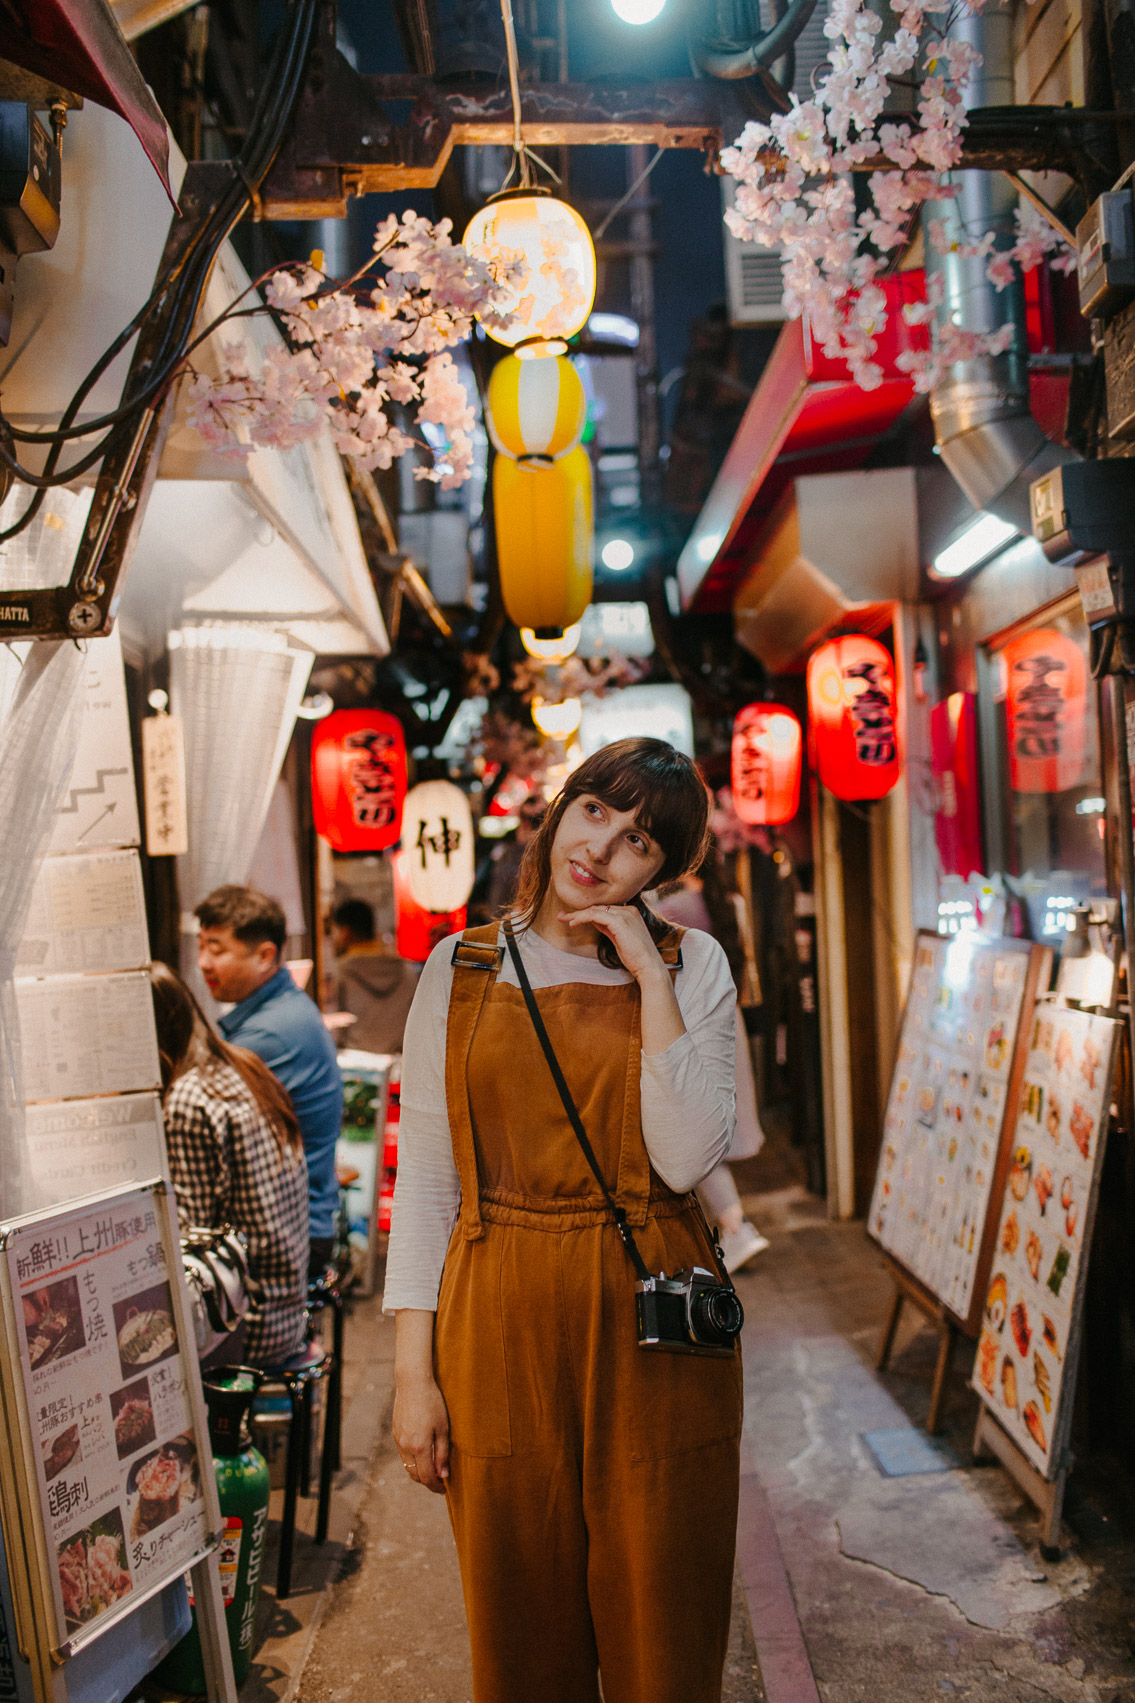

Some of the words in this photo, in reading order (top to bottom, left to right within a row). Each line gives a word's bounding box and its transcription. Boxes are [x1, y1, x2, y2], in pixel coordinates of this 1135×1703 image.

[83, 1269, 107, 1342] もつ焼
[37, 1393, 73, 1422] 量限定!
[38, 1391, 103, 1437] 州豚おすすめ串
